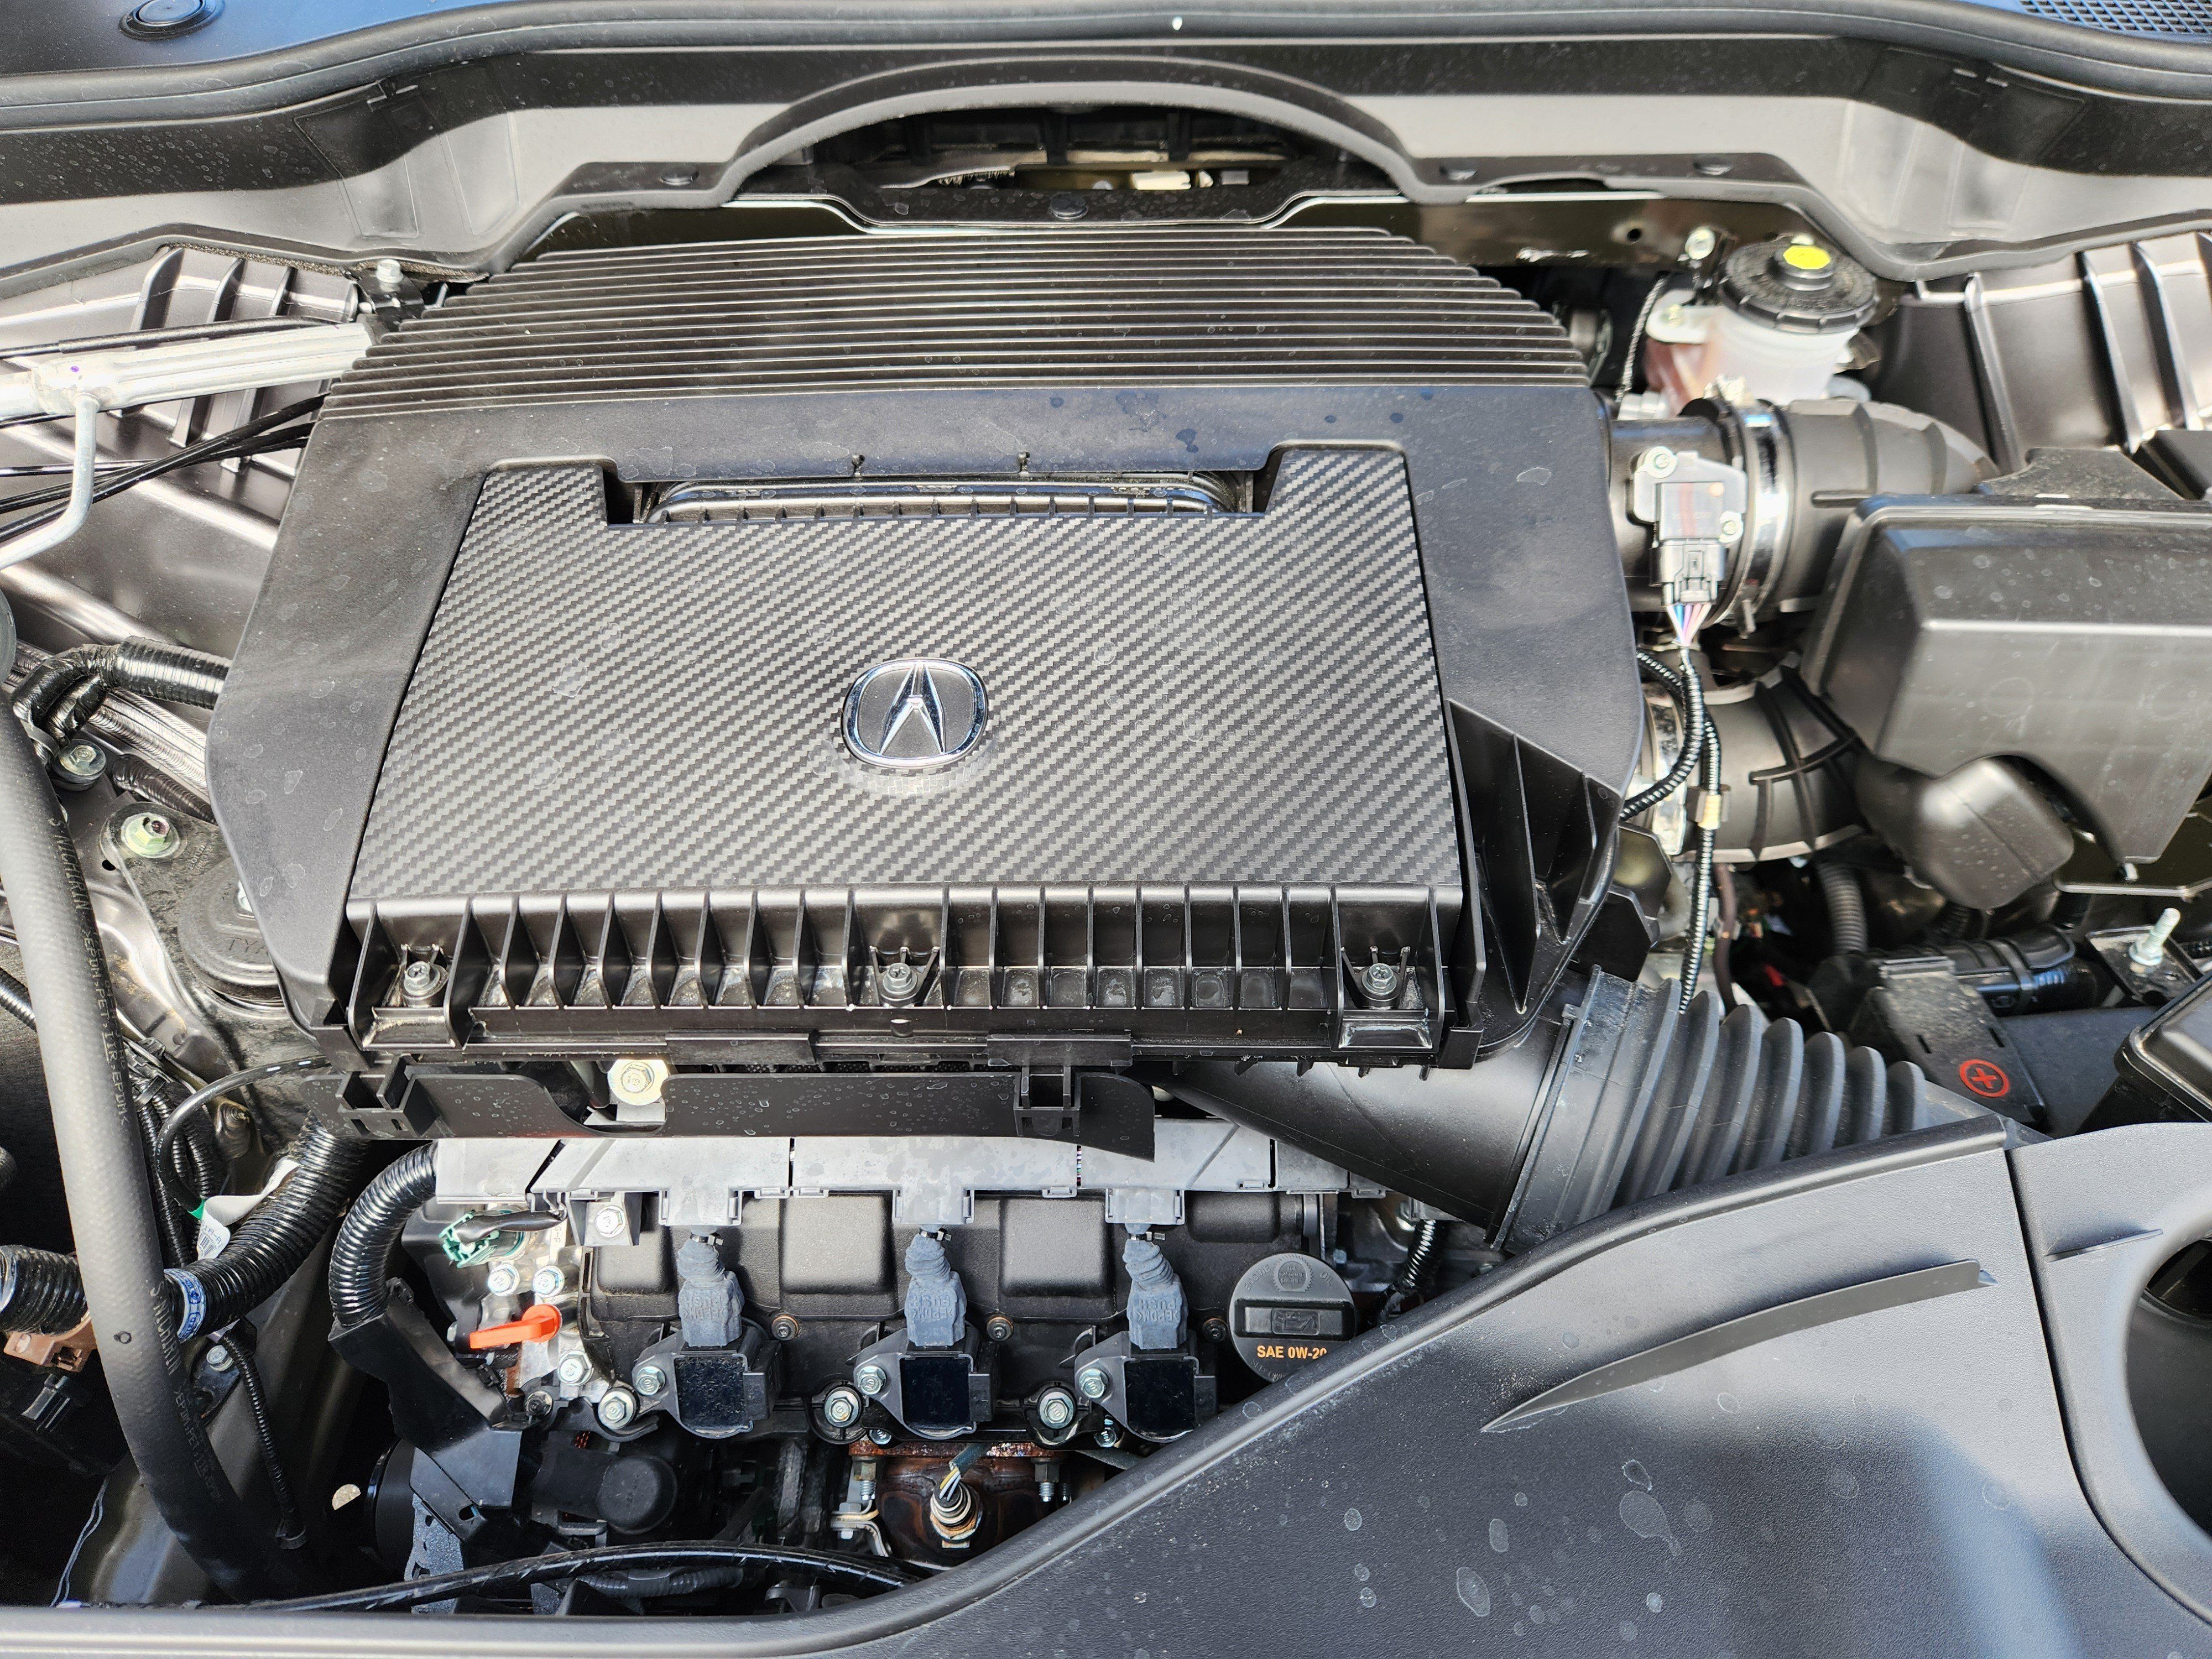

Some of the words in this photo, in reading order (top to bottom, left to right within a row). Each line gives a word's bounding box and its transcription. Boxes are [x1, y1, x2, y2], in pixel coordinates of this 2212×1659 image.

[1244, 1264, 1272, 1292] ENGINE
[1320, 1271, 1334, 1287] OIL
[1141, 1297, 1177, 1311] PUSH
[1257, 1345, 1284, 1358] SAE
